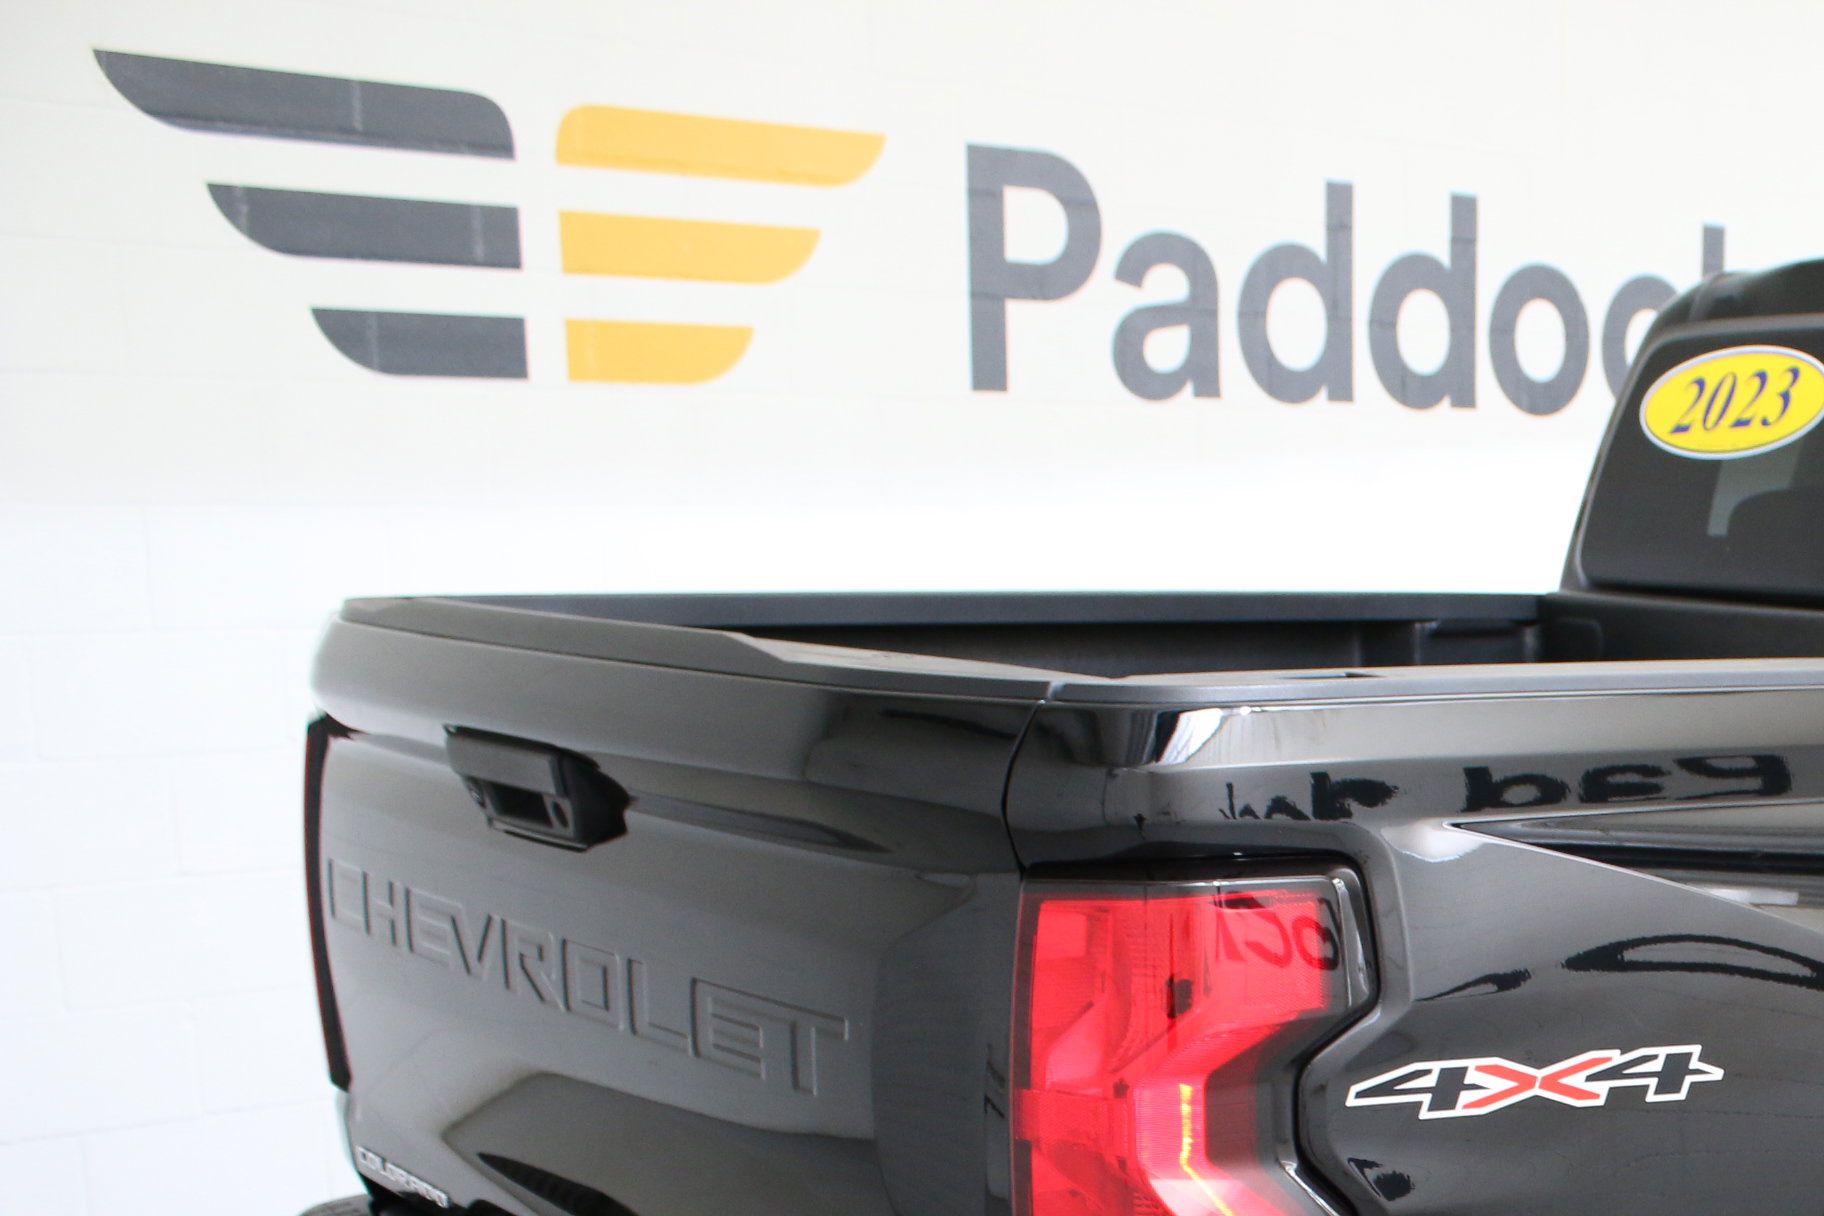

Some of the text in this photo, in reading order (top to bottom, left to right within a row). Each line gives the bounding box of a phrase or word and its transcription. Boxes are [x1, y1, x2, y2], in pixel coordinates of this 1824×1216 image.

[966, 142, 1725, 417] Paddoc
[1669, 366, 1800, 434] 2023
[328, 858, 850, 1097] CHEVROLET
